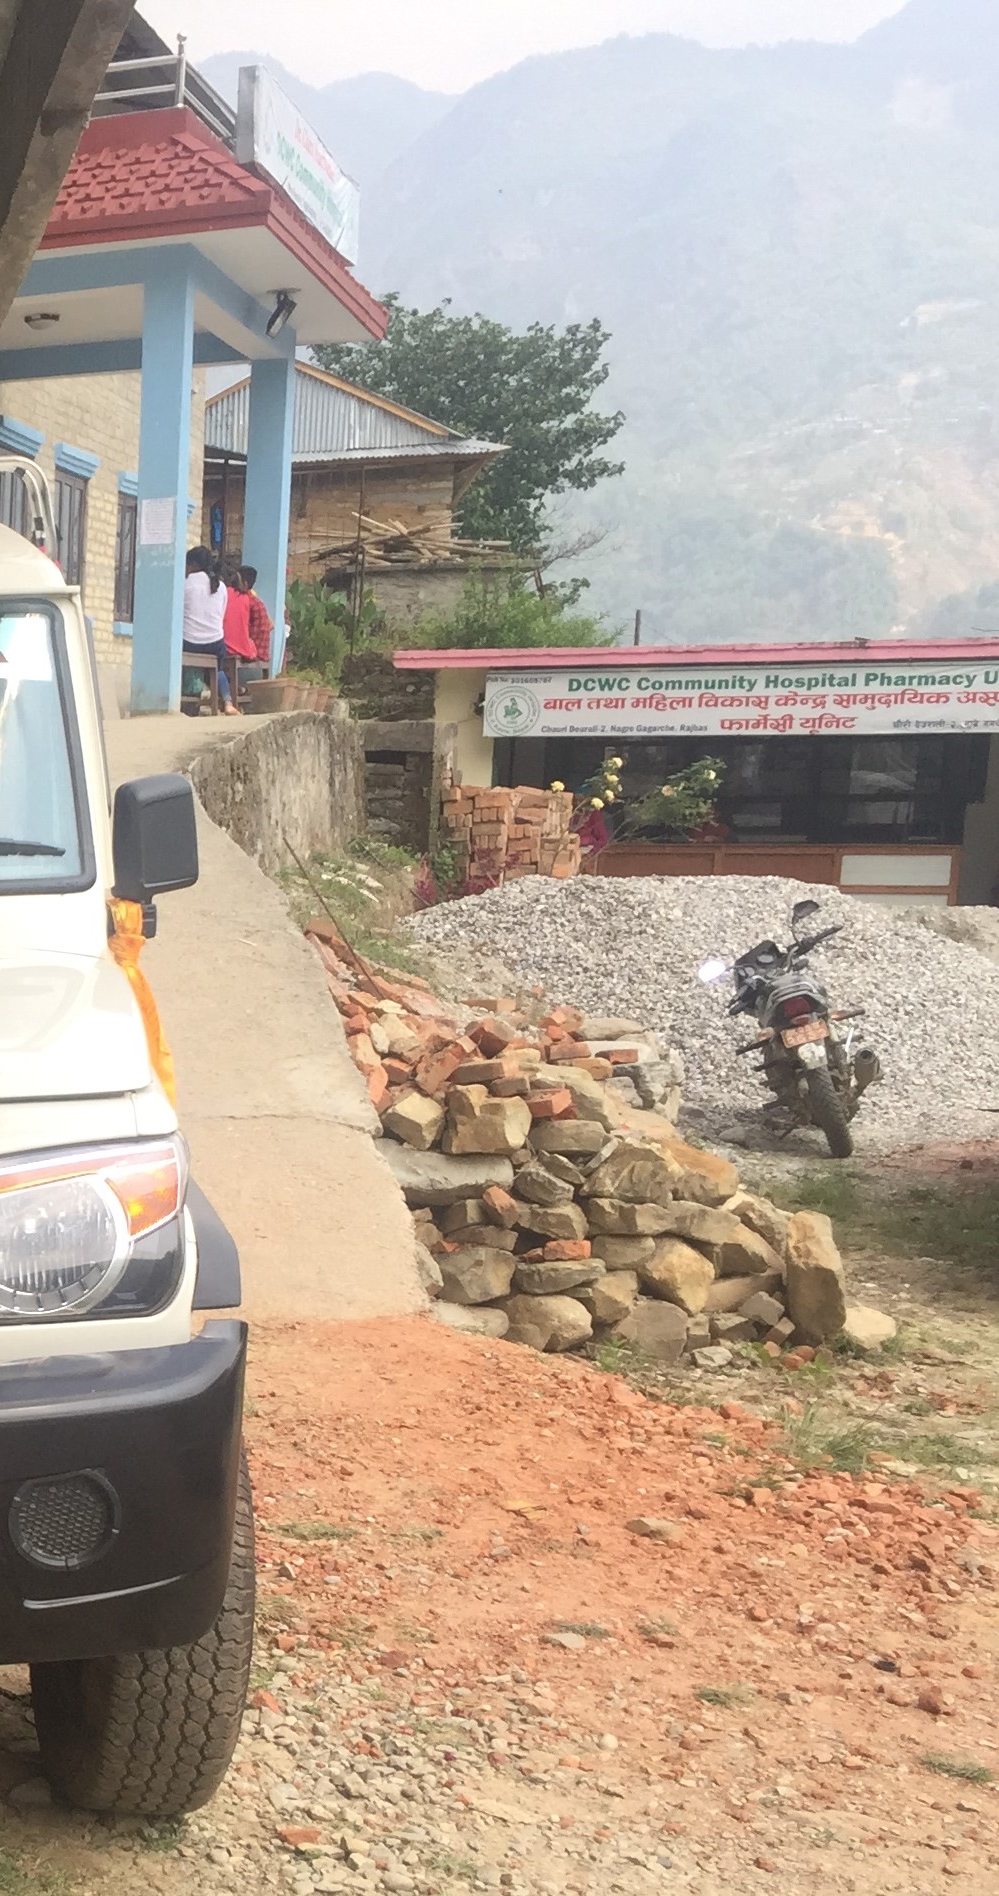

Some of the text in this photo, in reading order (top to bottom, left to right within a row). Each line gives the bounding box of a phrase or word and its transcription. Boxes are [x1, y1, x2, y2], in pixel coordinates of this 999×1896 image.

[568, 677, 631, 692] DCWC
[636, 675, 758, 692] Community
[764, 673, 857, 690] Hospital
[864, 671, 978, 688] Pharmacy
[543, 698, 583, 711] बाल
[586, 697, 627, 710] तथा
[631, 692, 694, 711] महिला
[698, 692, 771, 710] विकास
[774, 691, 830, 709] केन्द्र
[833, 688, 953, 711] सामुदायिक
[720, 712, 859, 735] फार्मेसी यूनिट
